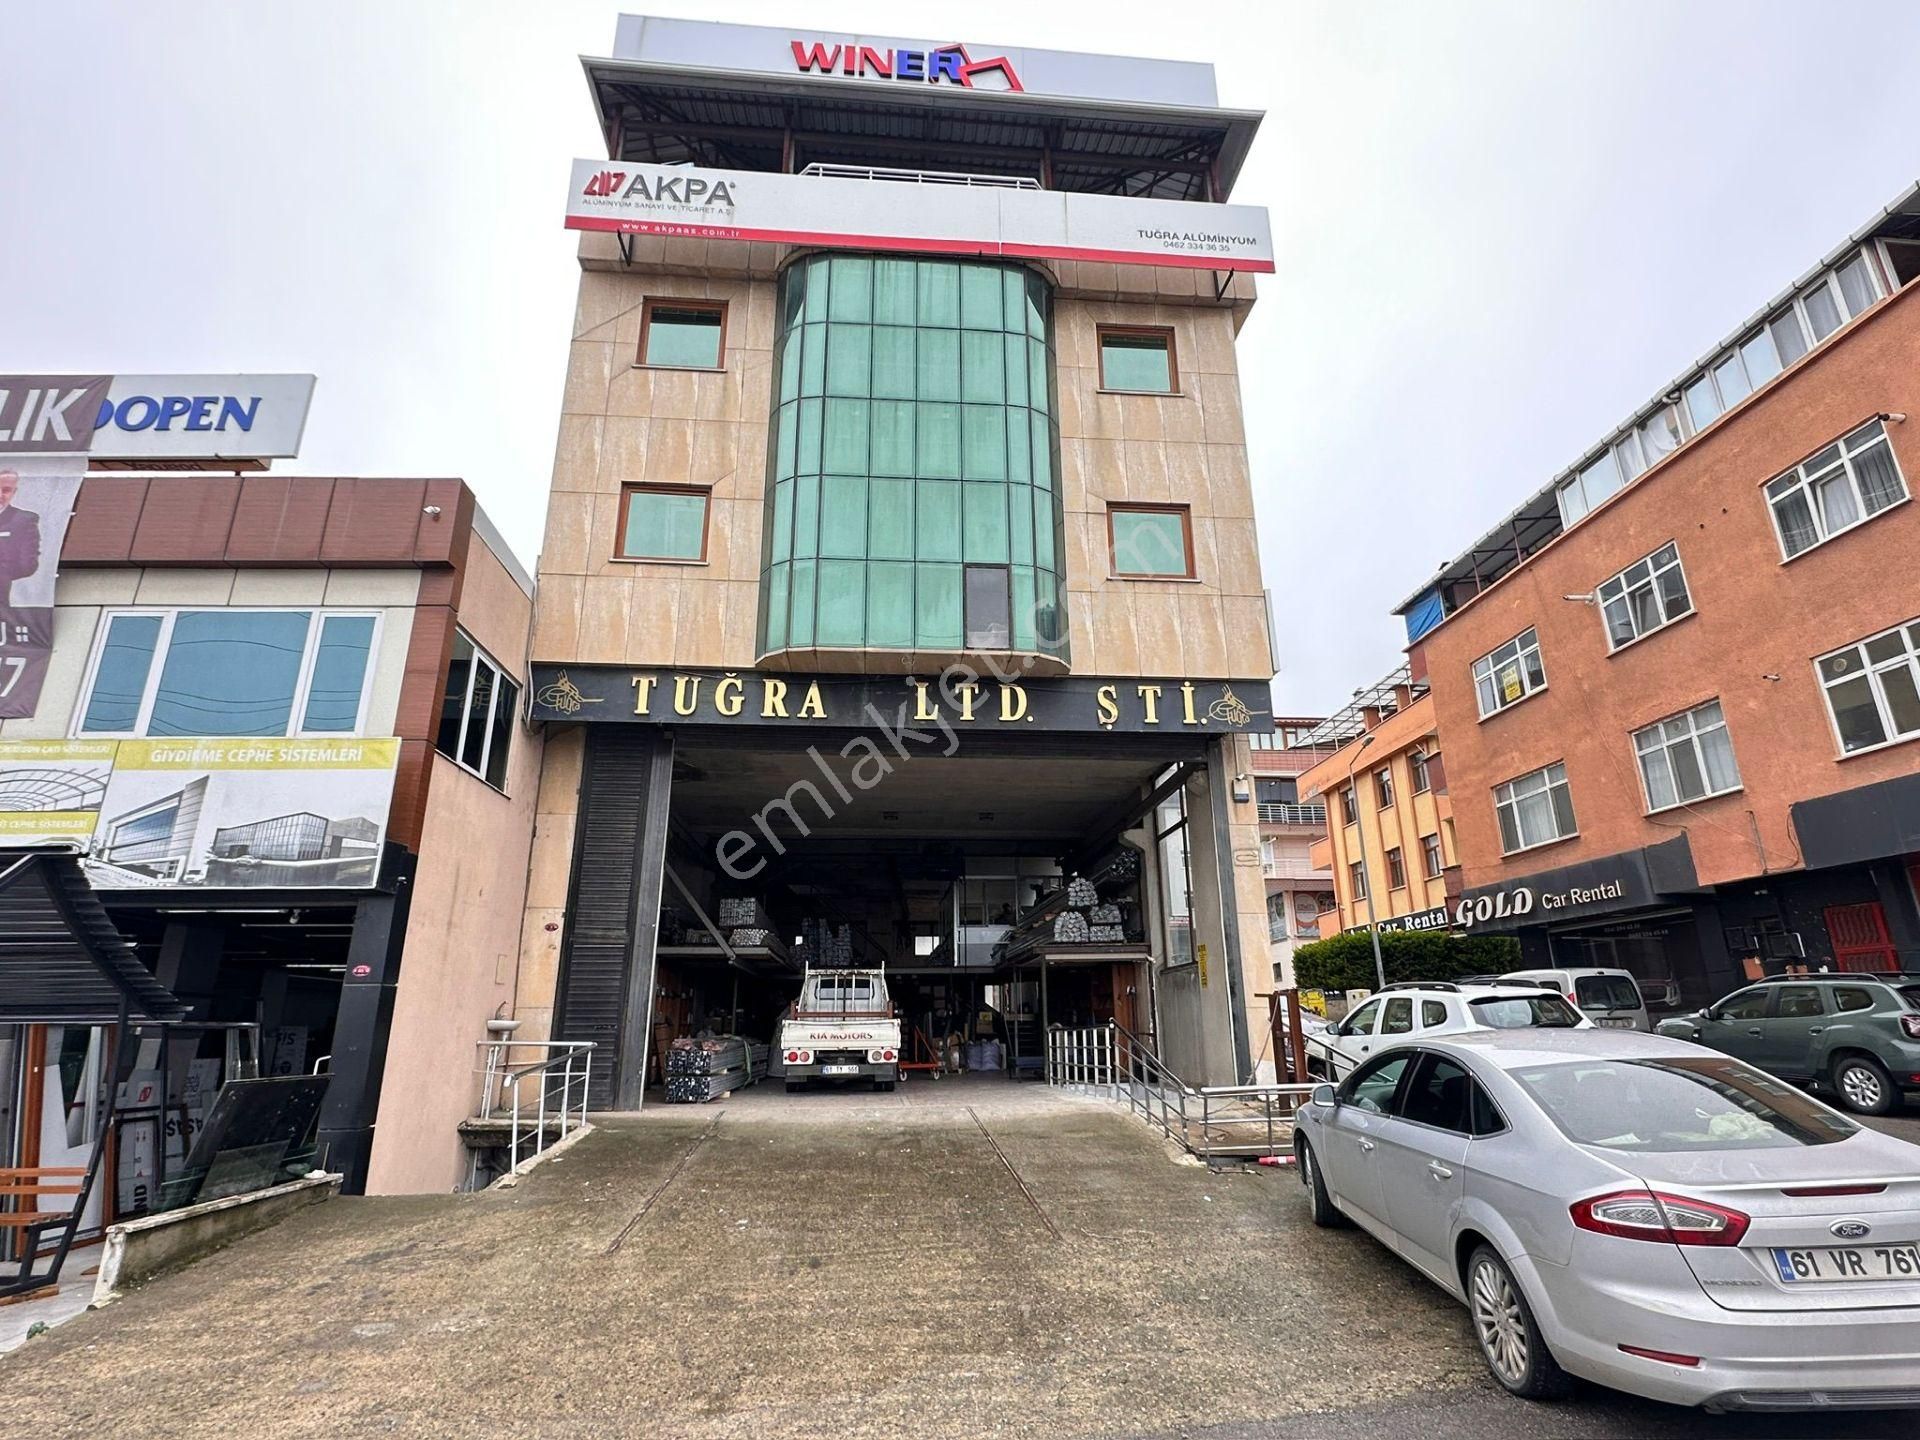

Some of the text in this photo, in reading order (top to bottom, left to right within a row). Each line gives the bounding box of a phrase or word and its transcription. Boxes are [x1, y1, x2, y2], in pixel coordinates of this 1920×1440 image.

[622, 173, 735, 207] AKPA
[1138, 228, 1180, 241] TUĞRA
[631, 672, 1208, 731] TUĞRA LTD. ŞTİ.
[151, 746, 363, 762] GİYDİRME CEPHE SİSTEMLERİ
[1451, 880, 1622, 927] GOLD Car Rental
[1403, 907, 1448, 931] Rental
[810, 1031, 873, 1040] KIA MOTORS
[1791, 1251, 1821, 1278] 61
[1829, 1250, 1868, 1276] VR
[1874, 1248, 1920, 1275] 761
